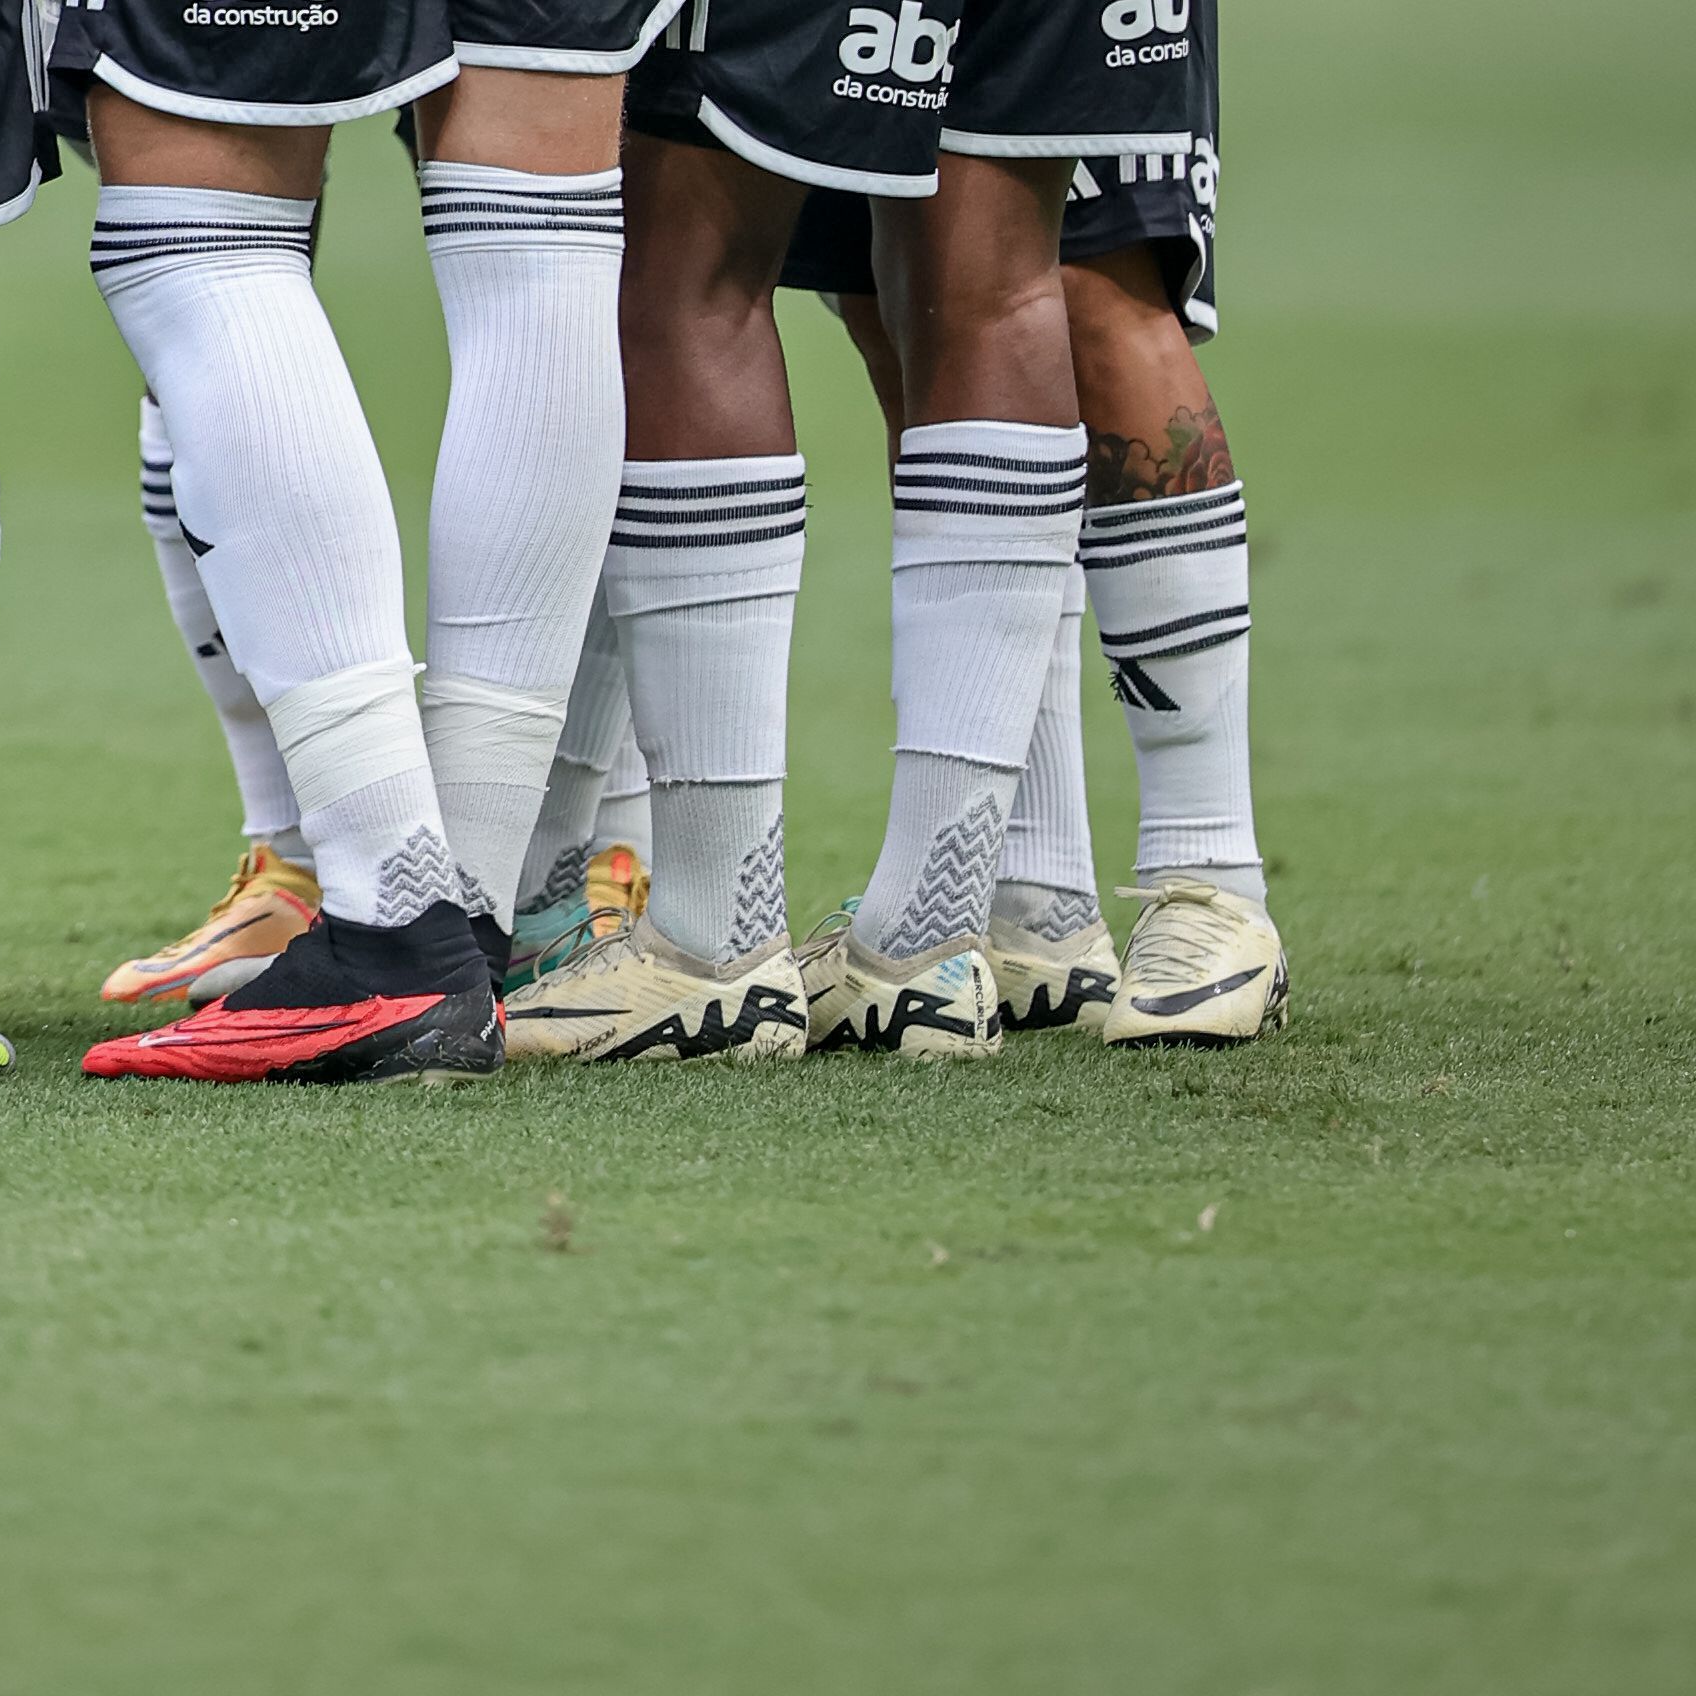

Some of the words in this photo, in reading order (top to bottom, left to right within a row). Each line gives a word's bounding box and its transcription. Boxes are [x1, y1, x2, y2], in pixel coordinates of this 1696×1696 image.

[183, 4, 211, 26] da
[213, 4, 339, 32] construção
[1105, 44, 1137, 69] da
[833, 74, 863, 100] da
